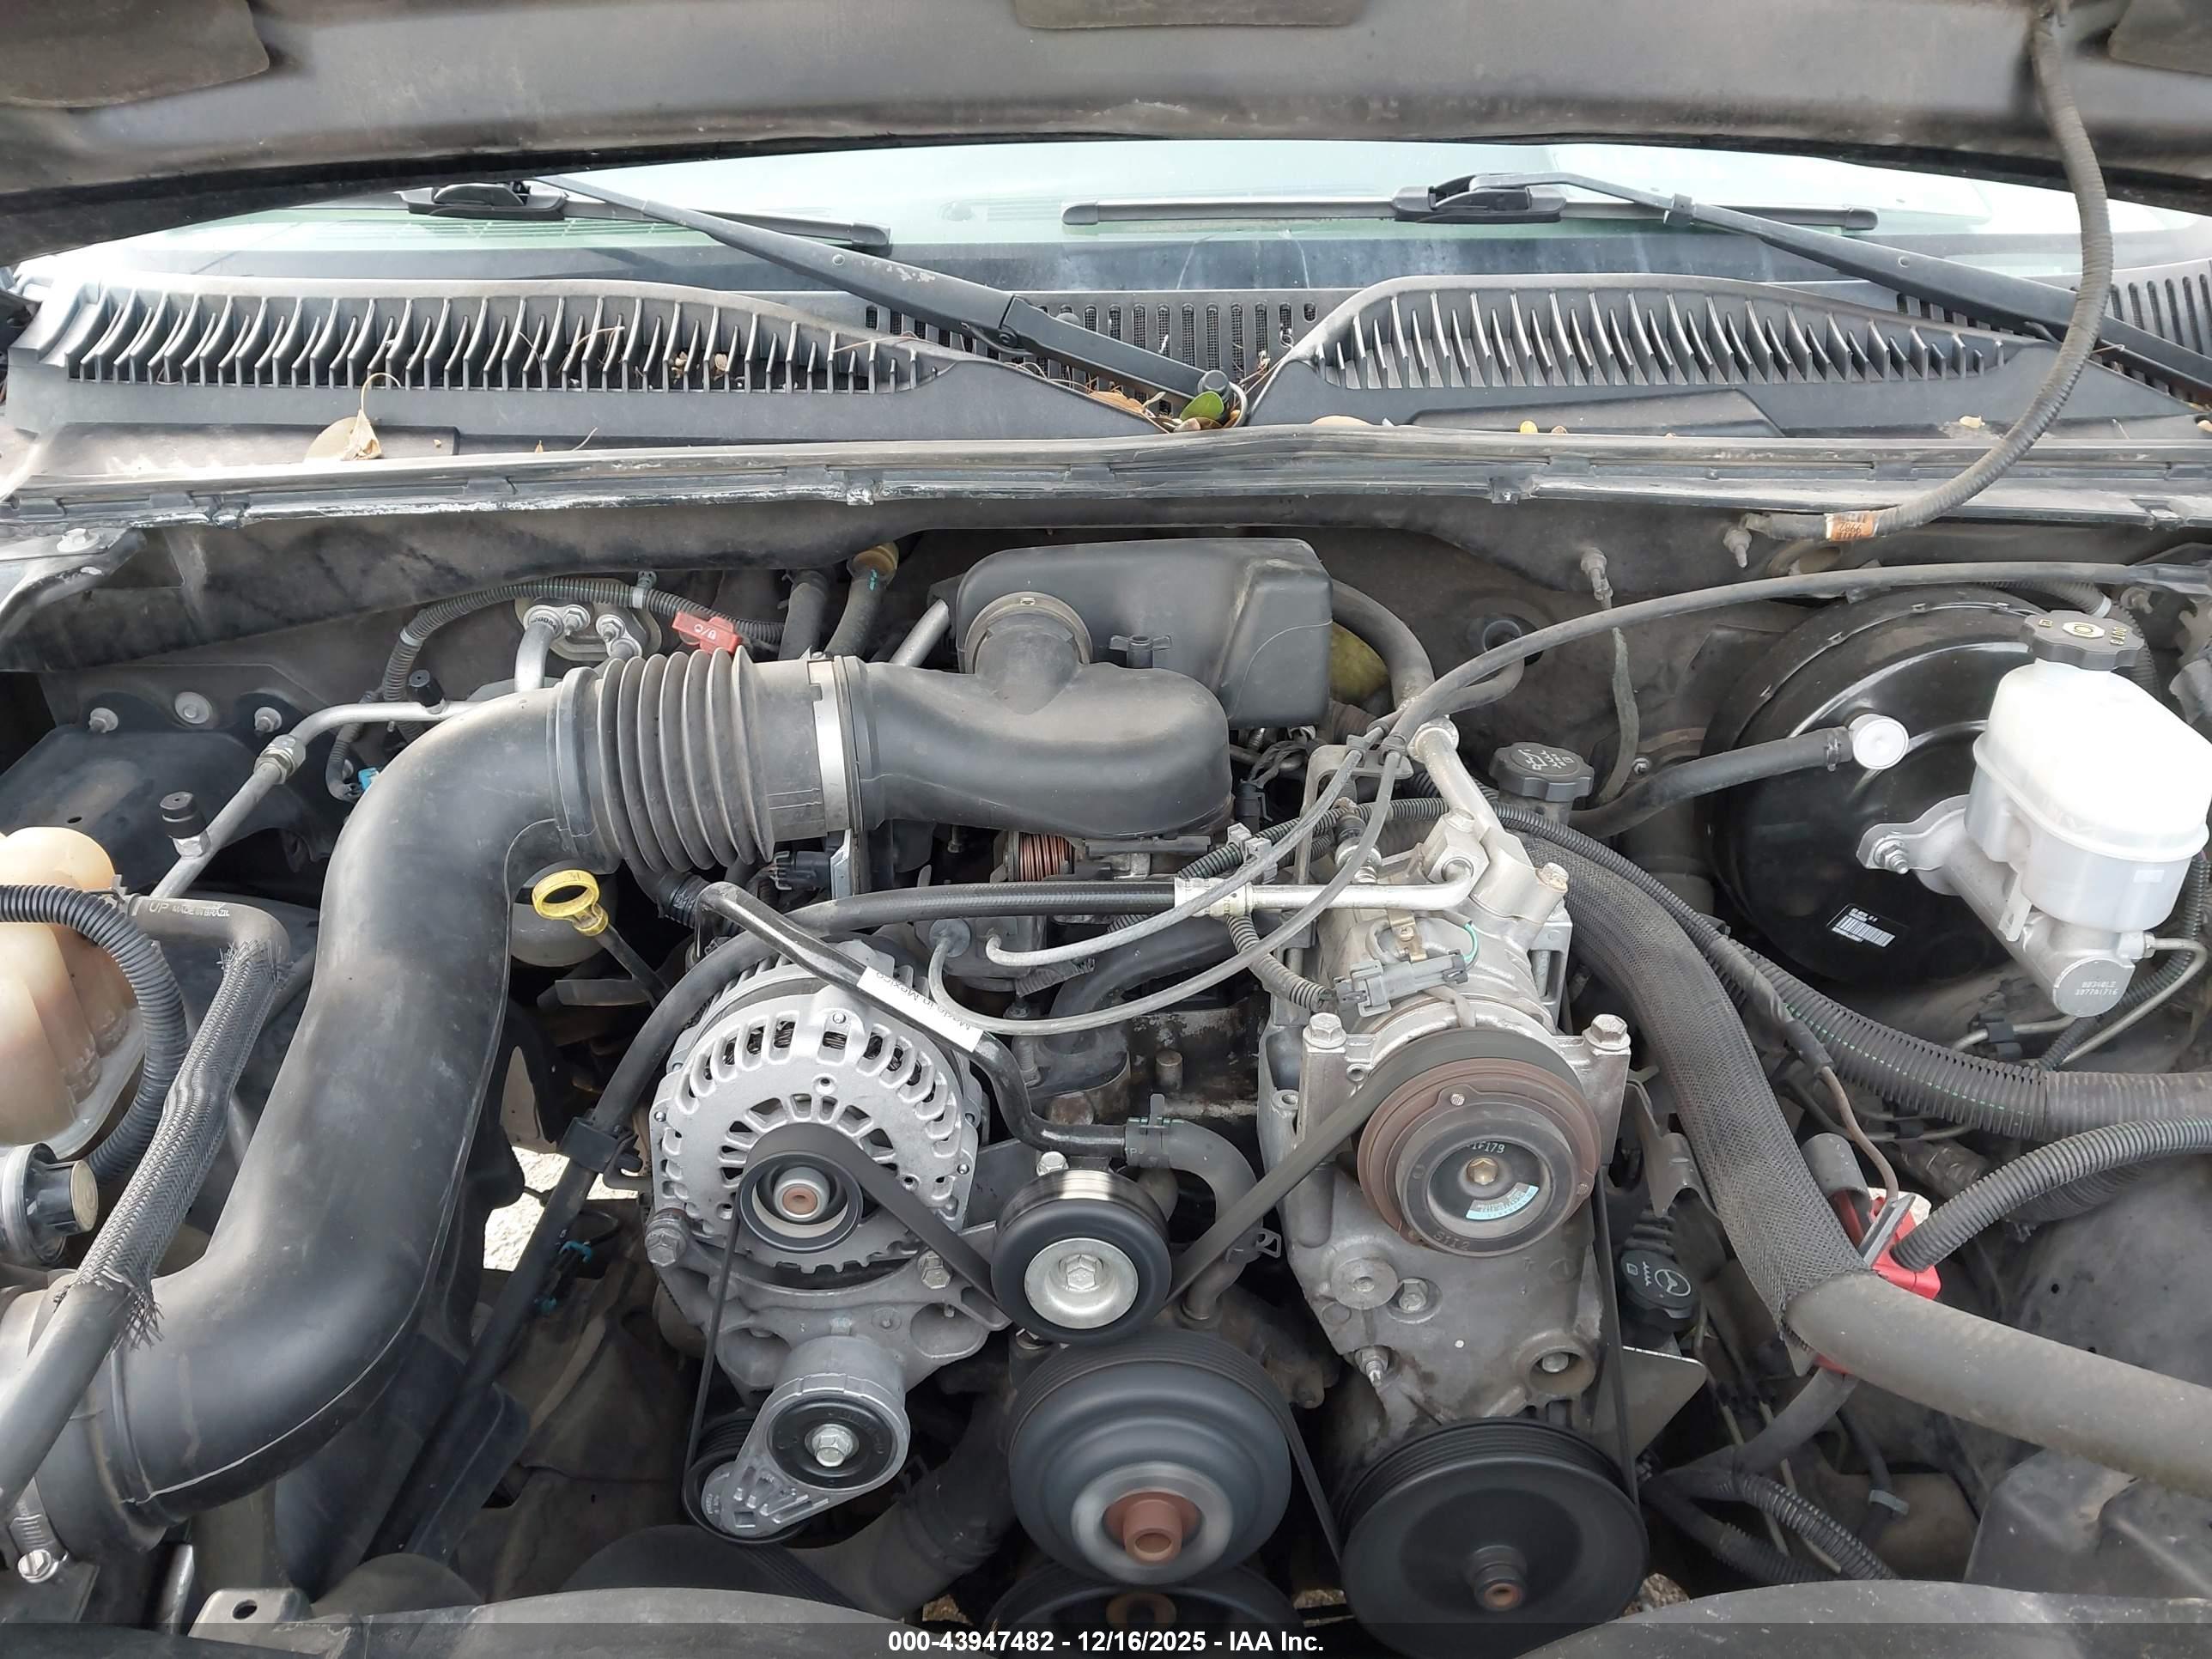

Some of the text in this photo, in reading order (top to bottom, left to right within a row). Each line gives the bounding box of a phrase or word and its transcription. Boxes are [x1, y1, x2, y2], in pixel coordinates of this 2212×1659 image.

[149, 901, 169, 913] UP
[172, 905, 194, 915] MADE
[876, 971, 918, 1001] Mexico
[922, 998, 935, 1010] in
